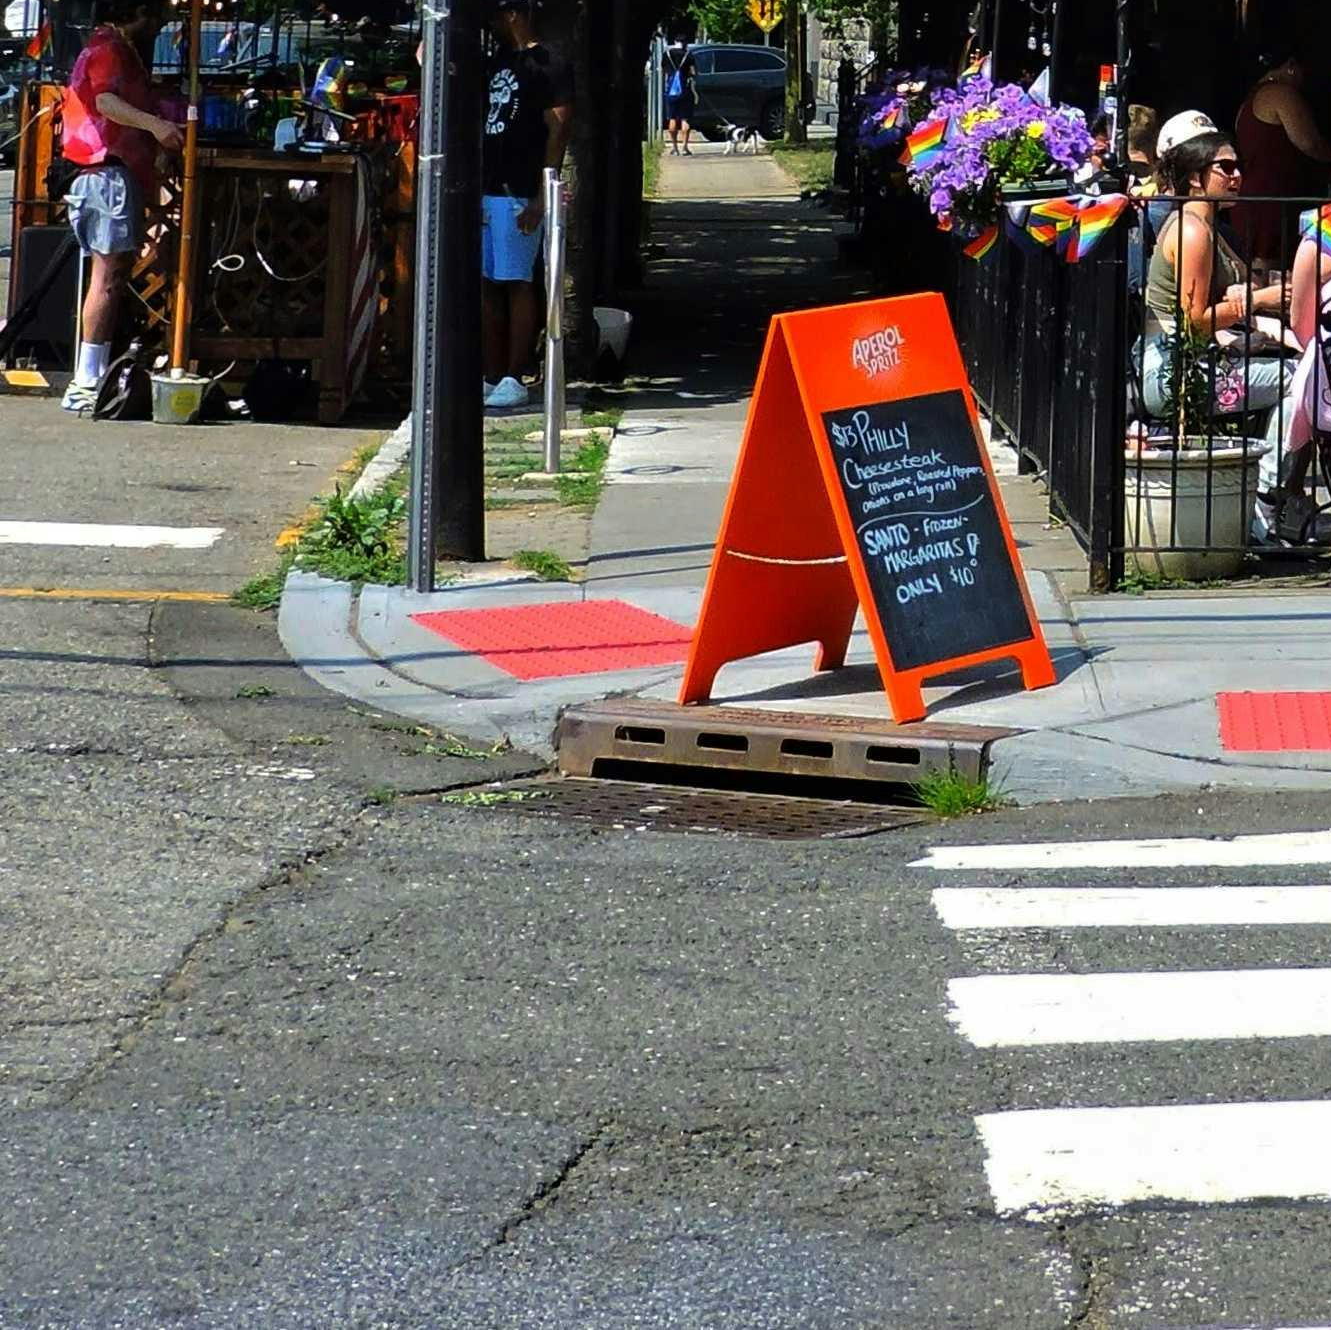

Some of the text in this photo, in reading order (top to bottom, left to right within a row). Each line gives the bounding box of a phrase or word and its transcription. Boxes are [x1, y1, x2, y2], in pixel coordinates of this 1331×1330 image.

[852, 325, 905, 370] APEROL
[864, 347, 901, 379] SPRITZ
[843, 449, 946, 489] Cheesesteak
[864, 523, 911, 556] SANTO
[883, 537, 965, 575] MARGARITAS
[896, 565, 975, 604] ONLY $10
